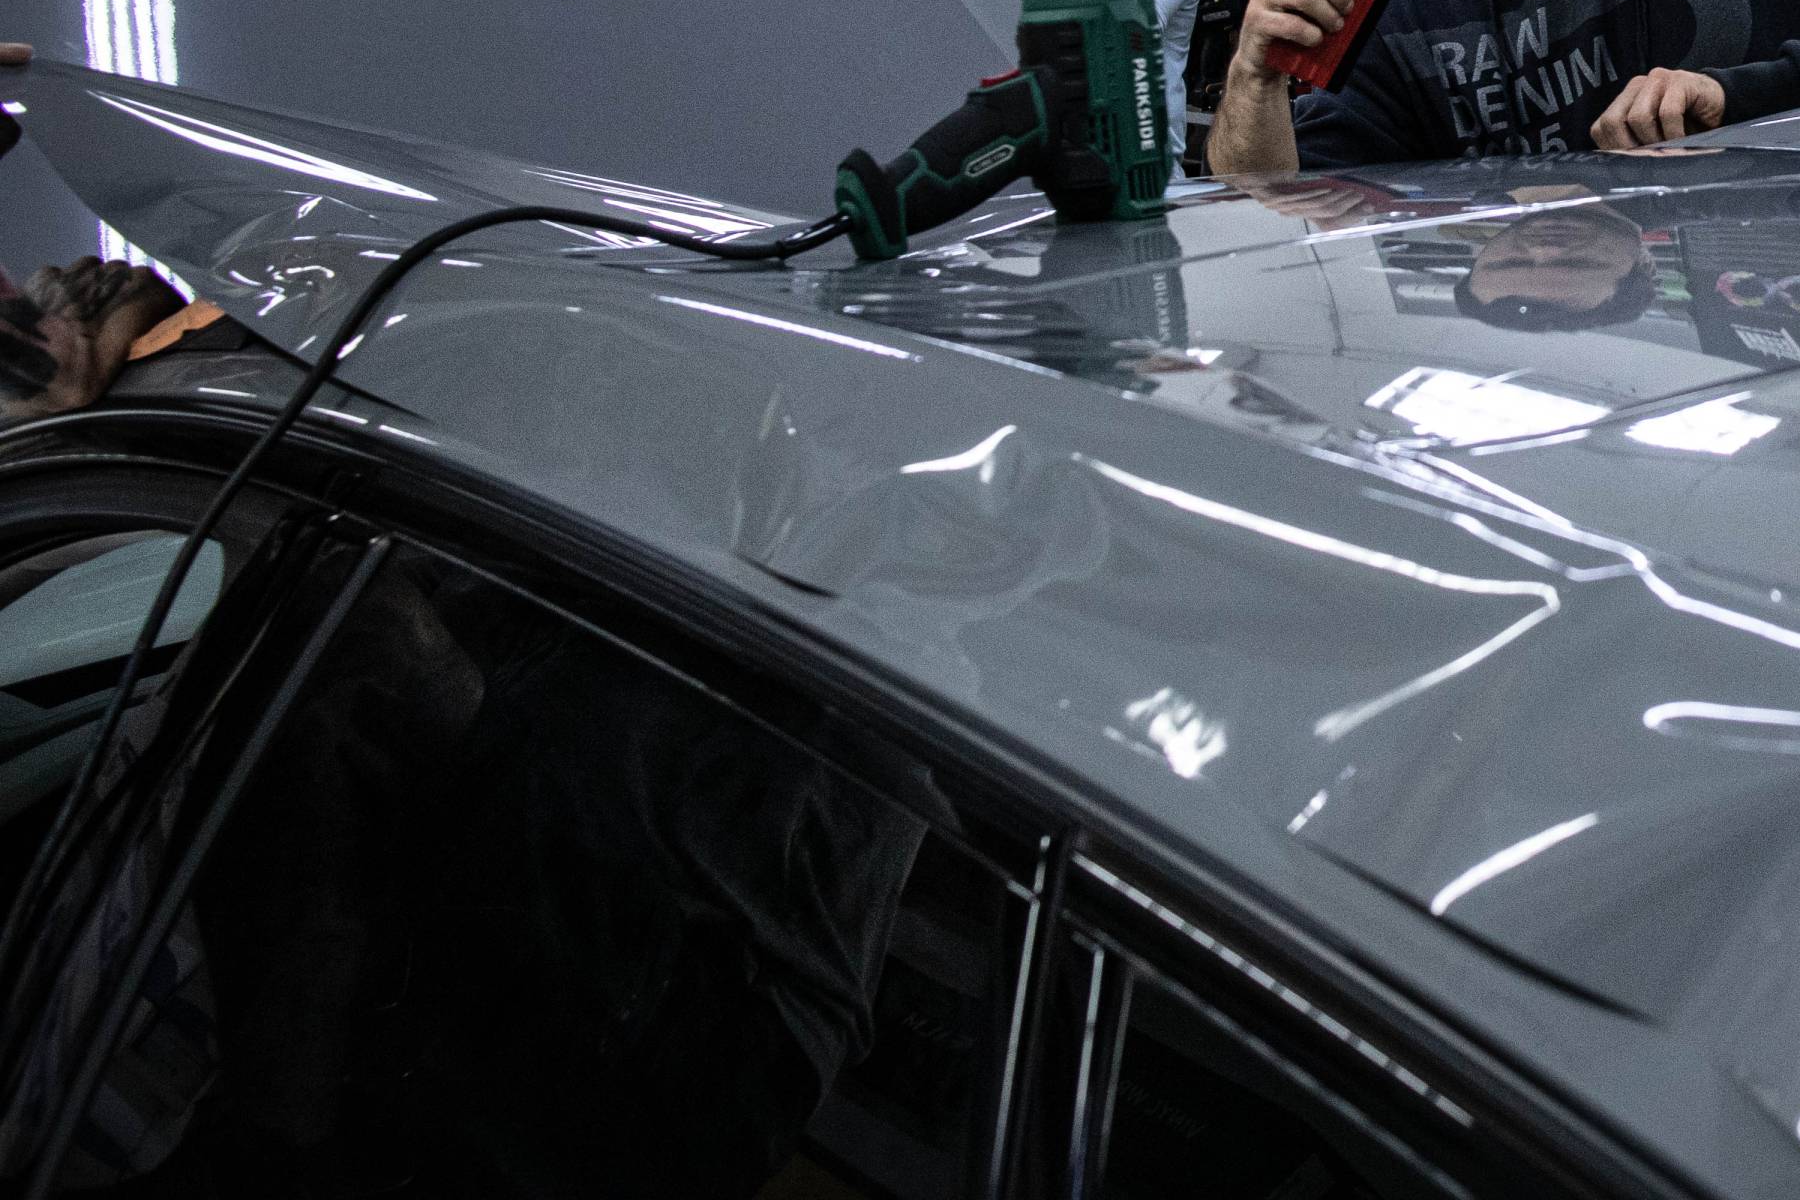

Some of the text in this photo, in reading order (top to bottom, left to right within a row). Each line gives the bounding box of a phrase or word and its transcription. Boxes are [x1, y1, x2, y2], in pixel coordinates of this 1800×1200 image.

[1432, 6, 1549, 89] RAW
[1448, 35, 1619, 138] DENIM
[1132, 57, 1156, 151] PARKSIDE
